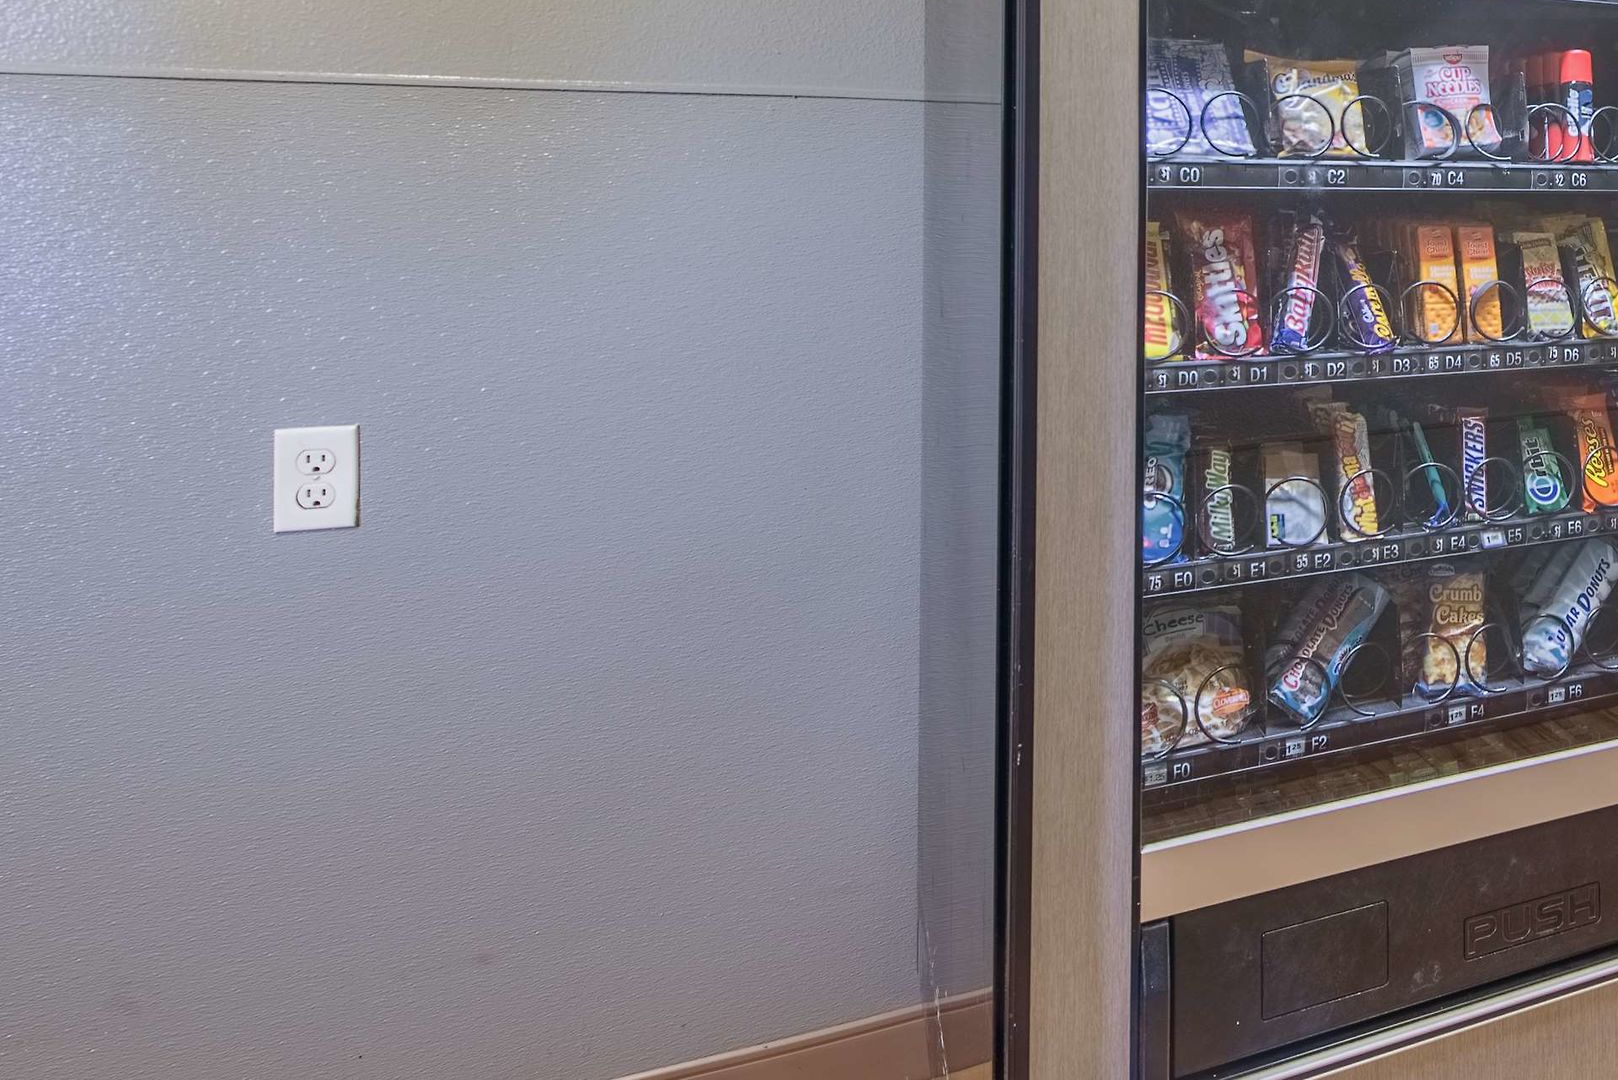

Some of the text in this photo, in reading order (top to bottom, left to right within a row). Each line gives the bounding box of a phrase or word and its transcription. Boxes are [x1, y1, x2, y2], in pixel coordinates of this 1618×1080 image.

[1440, 66, 1471, 82] CUP
[1425, 79, 1481, 98] NOODLES
[1180, 167, 1200, 183] C0
[1328, 169, 1346, 184] C2
[1448, 172, 1464, 185] C4
[1572, 173, 1587, 186] C6
[1202, 229, 1247, 347] Skittles
[1445, 355, 1462, 368] D4
[1506, 352, 1521, 366] D5
[1564, 348, 1579, 361] D6
[1327, 362, 1345, 377] D2
[1393, 358, 1411, 372] D3
[1178, 370, 1198, 386] D0
[1250, 366, 1267, 381] D1
[1205, 449, 1235, 541] Milky Way
[1567, 520, 1582, 534] E6
[1451, 535, 1465, 549] E4
[1508, 528, 1522, 542] E5
[1383, 544, 1399, 559] E3
[1315, 553, 1331, 568] E2
[1250, 562, 1266, 577] E1
[1174, 571, 1193, 587] E0
[1429, 583, 1482, 602] Crumb
[1321, 583, 1354, 631] DONUTS
[1557, 558, 1612, 650] UGAR DONUTS
[1435, 604, 1485, 625] Cakes
[1143, 613, 1204, 636] Cheese
[1568, 685, 1582, 698] F6
[1470, 705, 1485, 718] F4
[1312, 736, 1327, 751] F2
[1173, 763, 1190, 778] F0
[1467, 886, 1598, 957] PUSH
